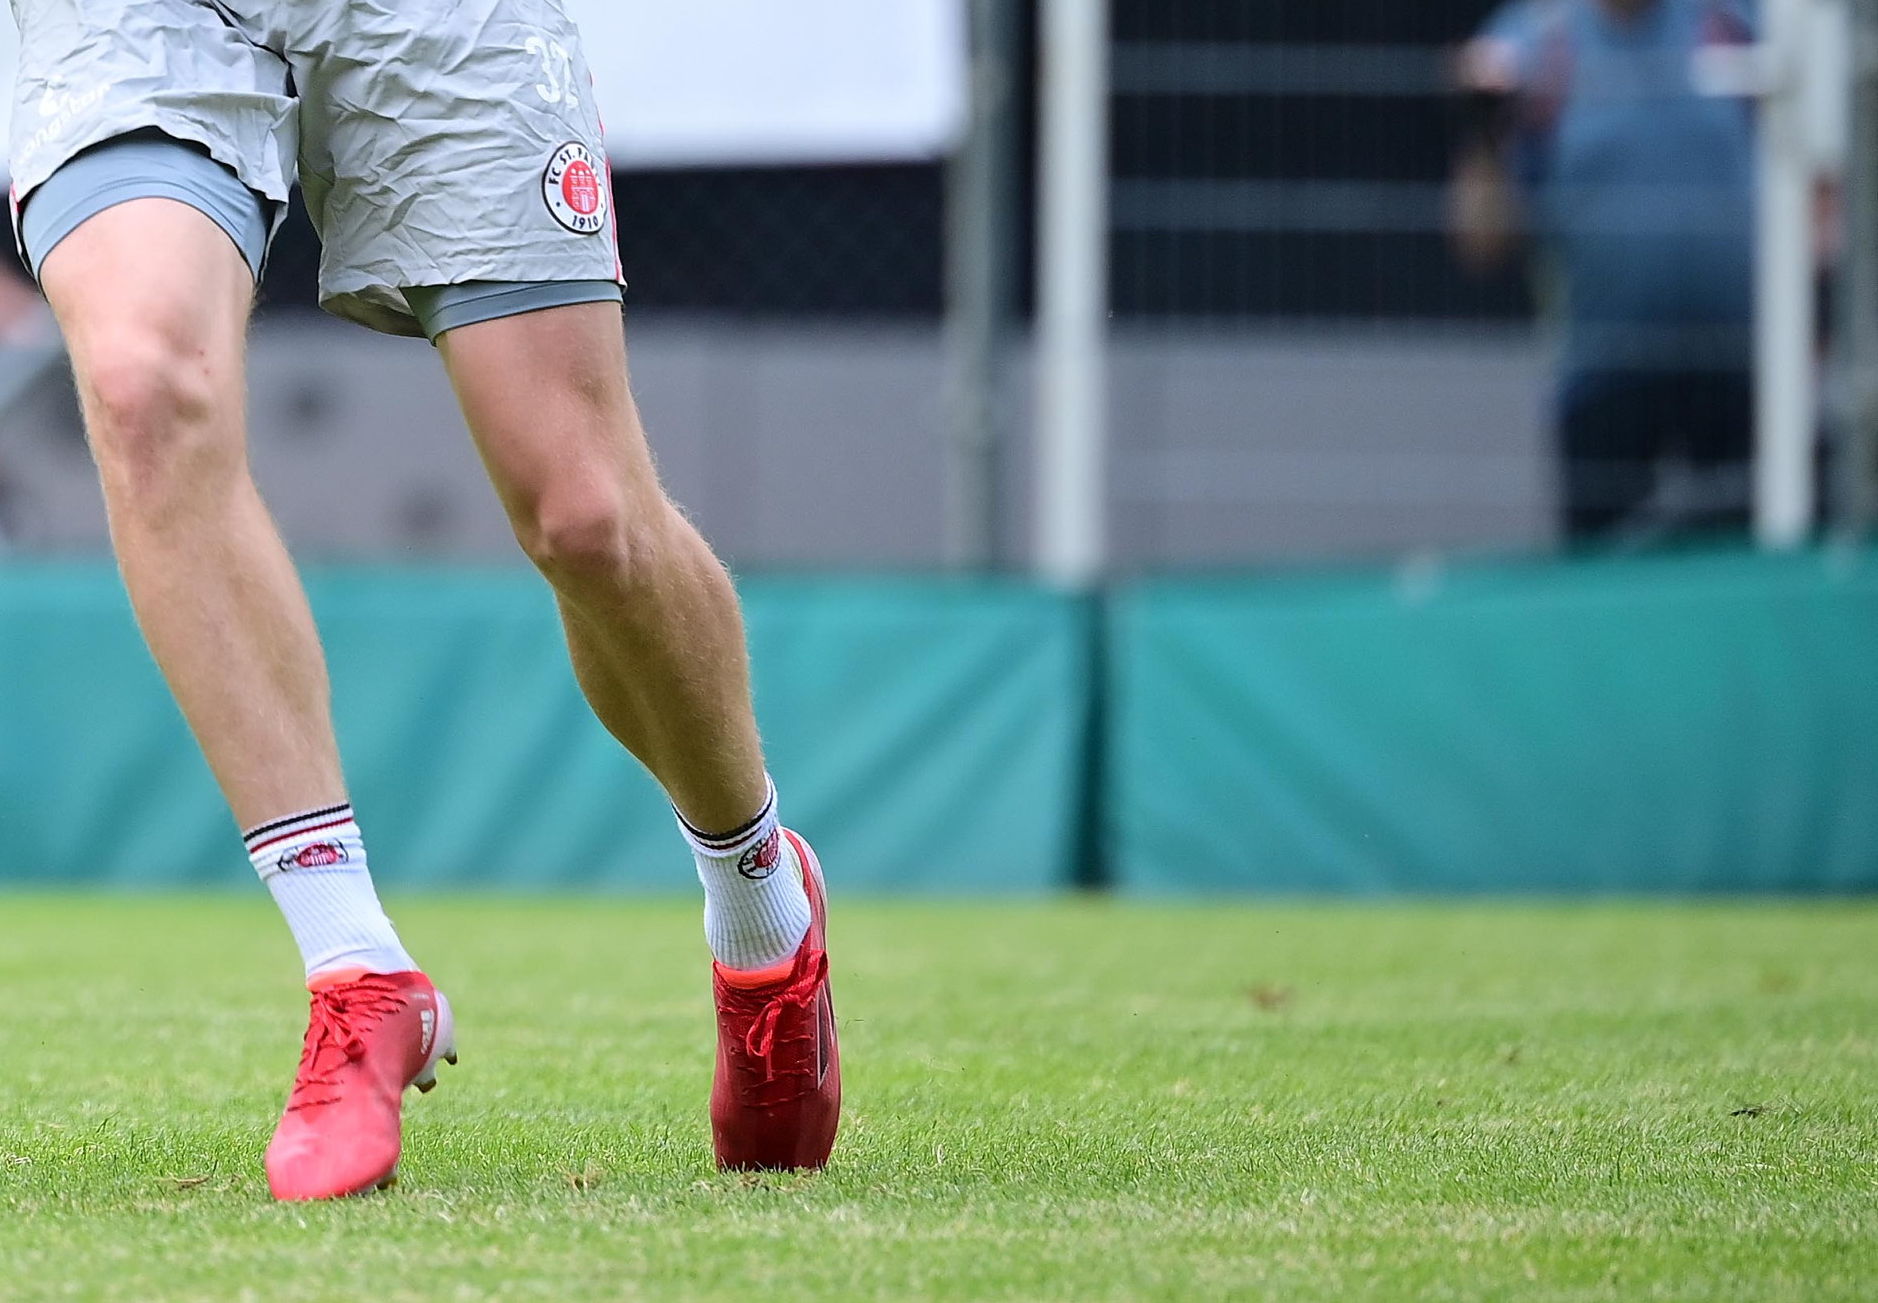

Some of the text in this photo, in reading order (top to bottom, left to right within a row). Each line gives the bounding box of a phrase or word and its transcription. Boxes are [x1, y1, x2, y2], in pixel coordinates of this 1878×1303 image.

[548, 149, 576, 185] FC ST.
[572, 214, 599, 229] 1910
